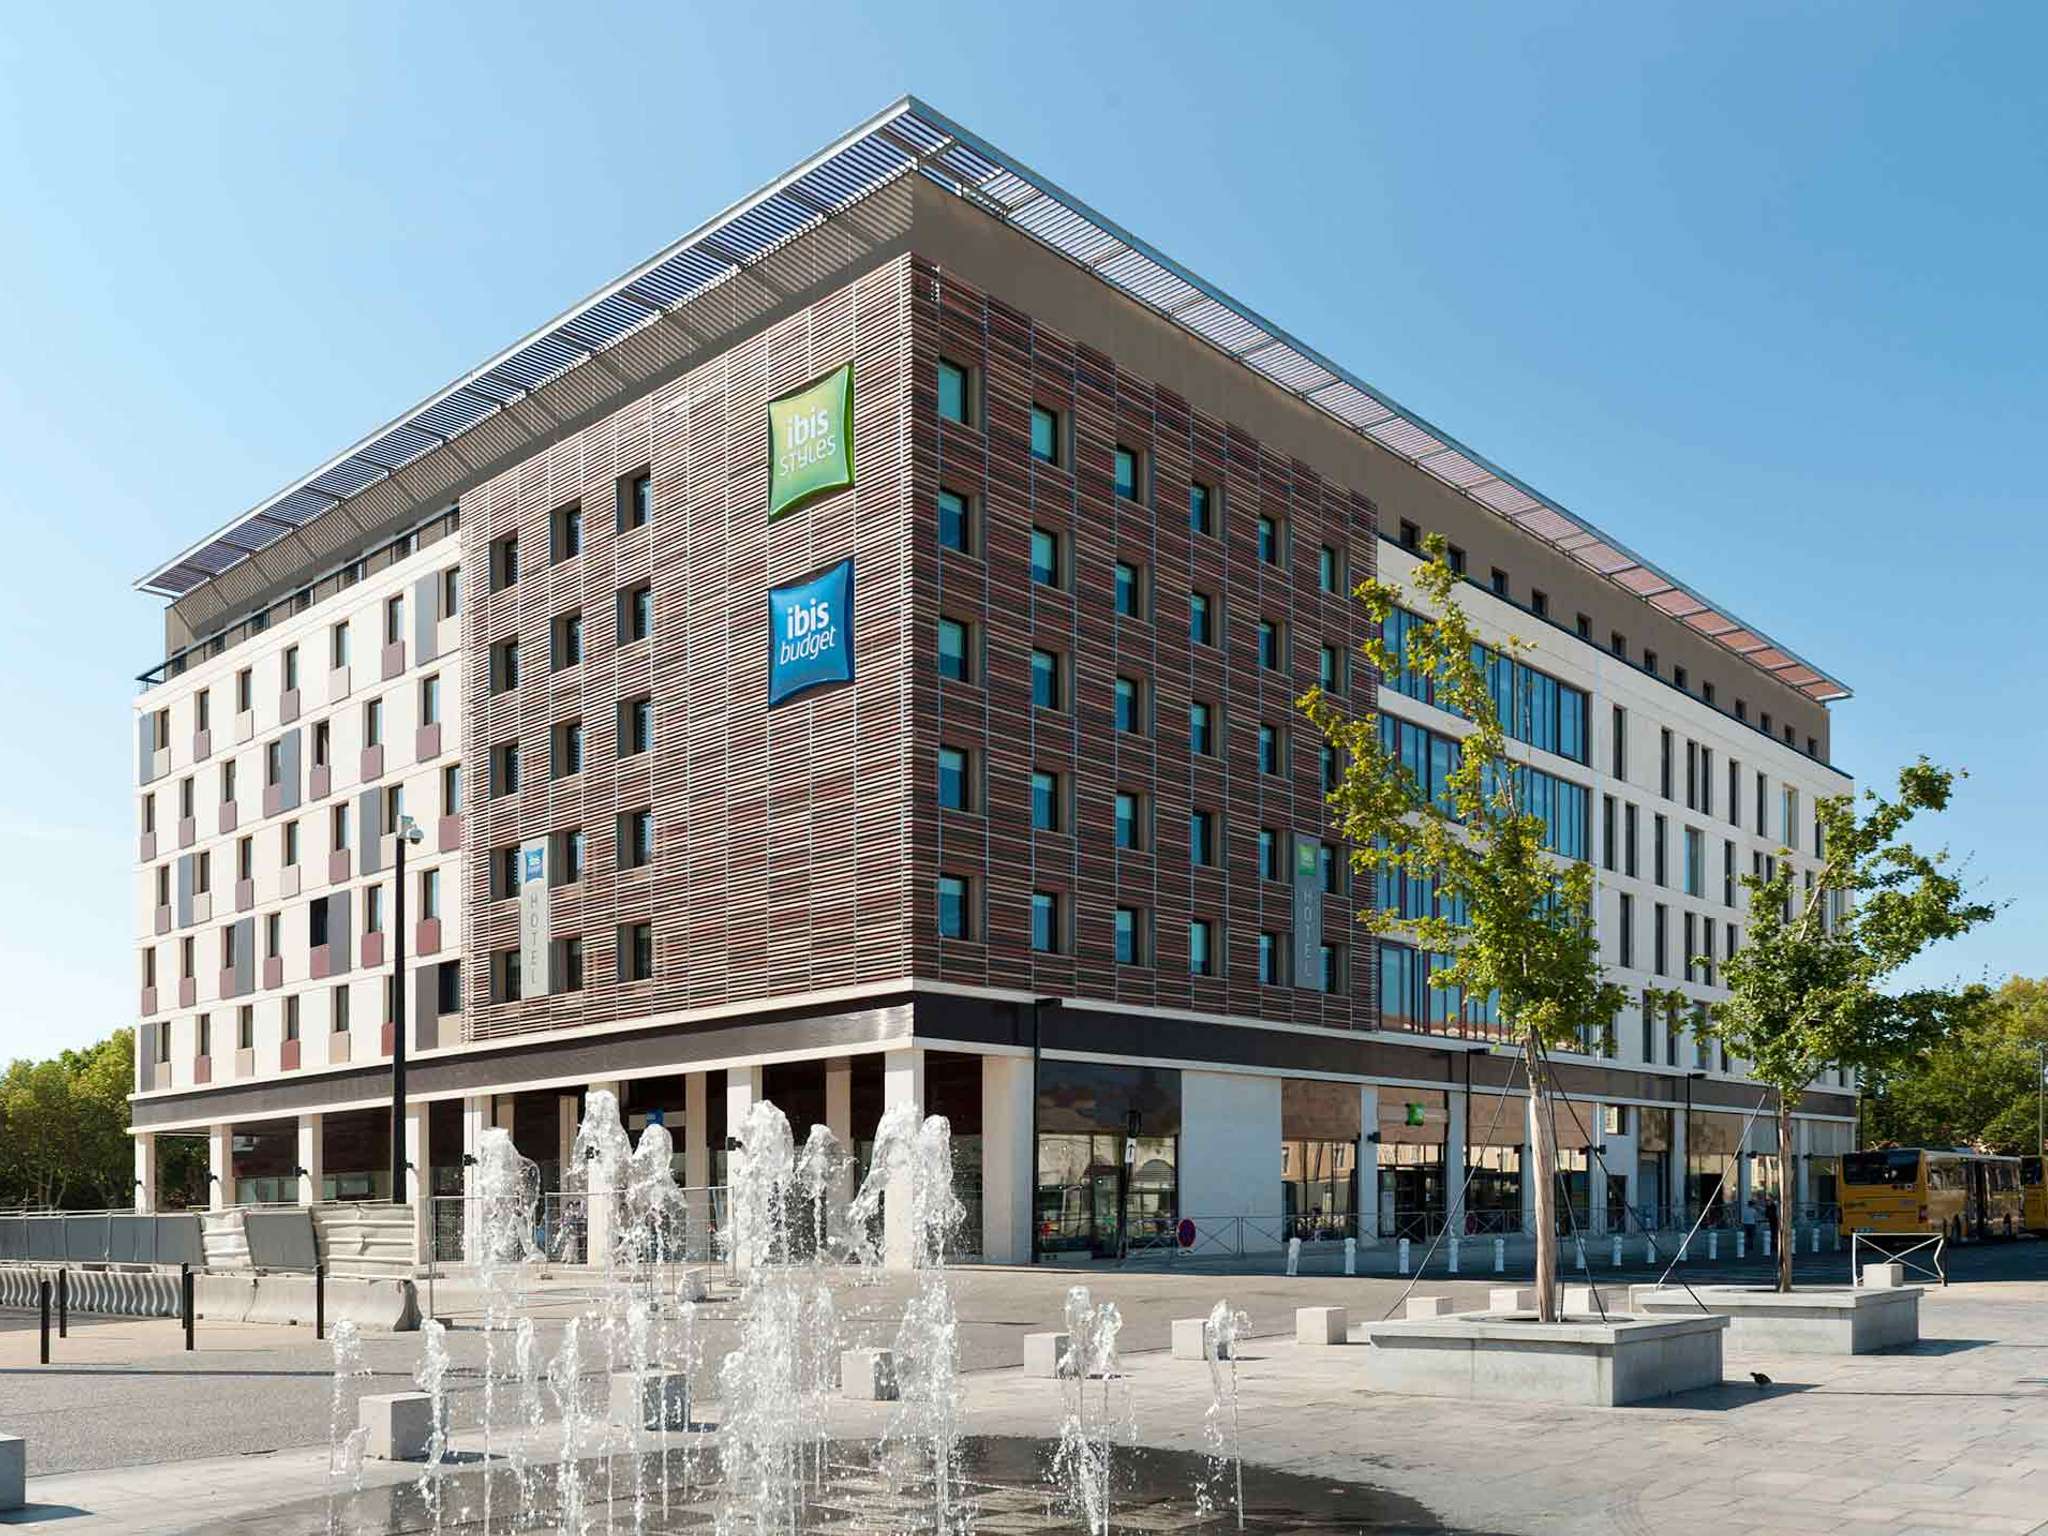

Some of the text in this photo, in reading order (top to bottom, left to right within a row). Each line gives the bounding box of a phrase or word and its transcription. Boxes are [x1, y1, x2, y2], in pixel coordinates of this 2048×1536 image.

[785, 406, 829, 449] ibis
[787, 598, 830, 640] ibis
[780, 625, 837, 665] budget
[529, 892, 539, 985] HOTEL
[1303, 889, 1313, 977] HOTEL
